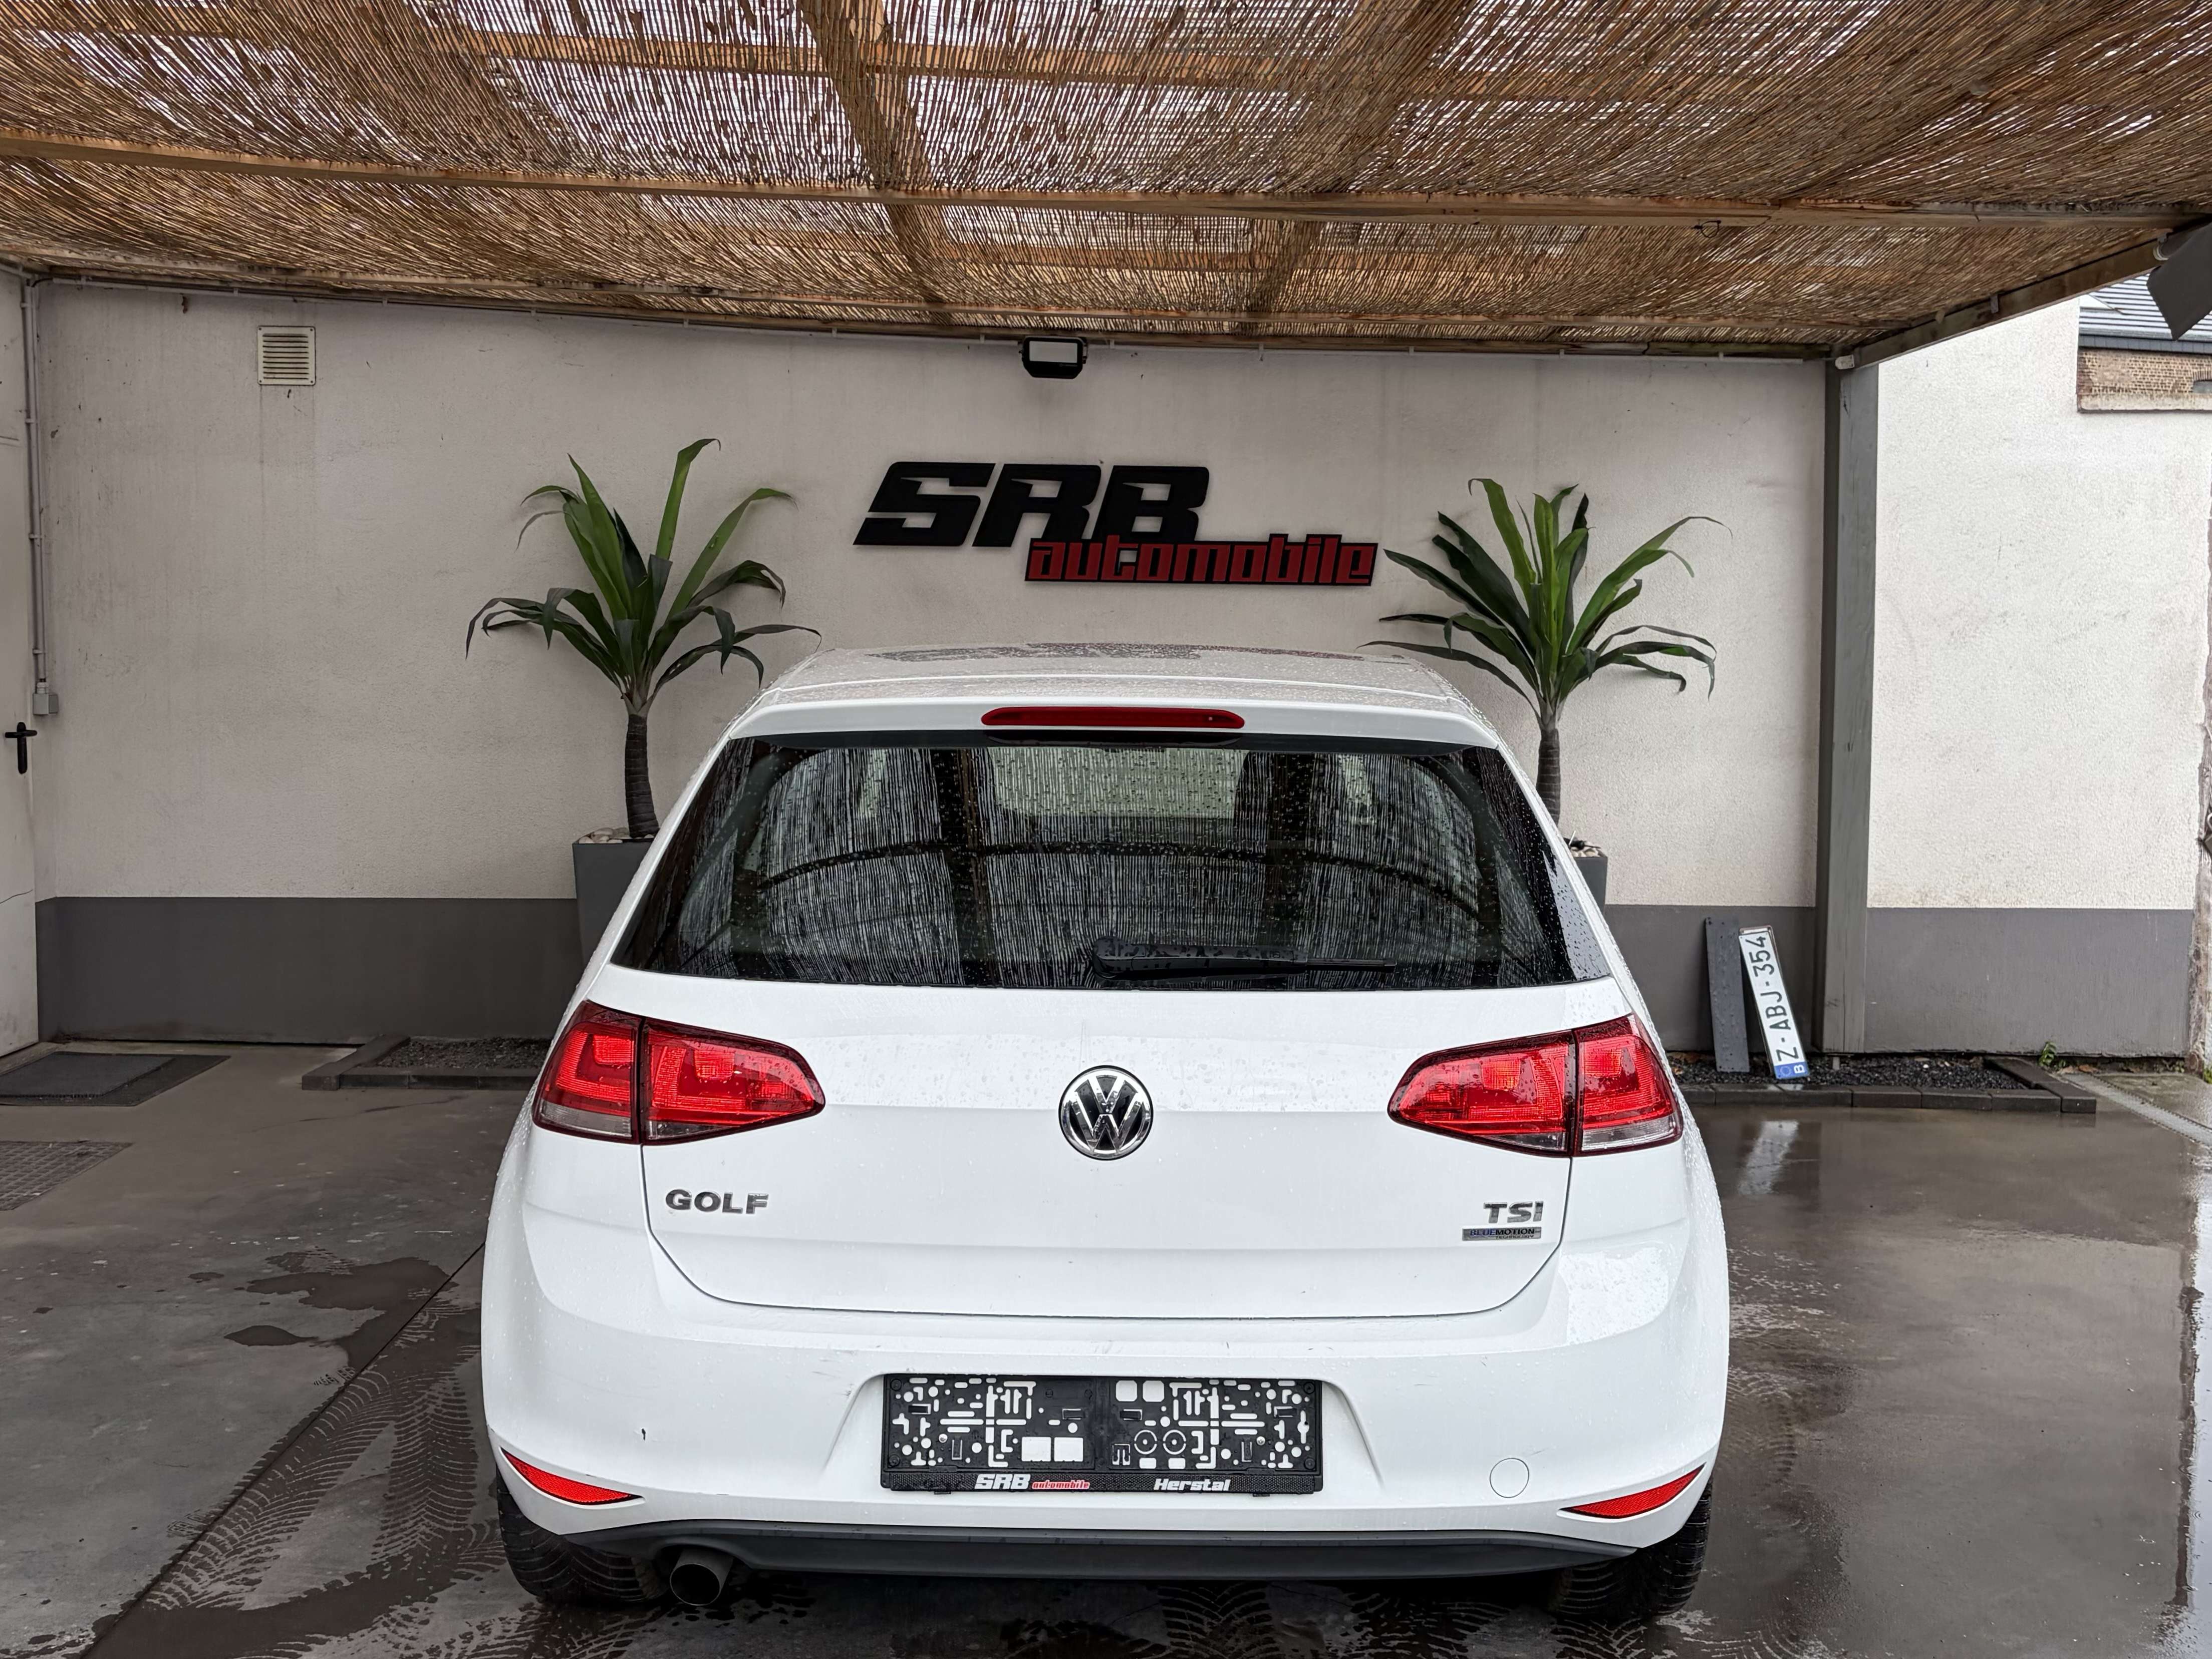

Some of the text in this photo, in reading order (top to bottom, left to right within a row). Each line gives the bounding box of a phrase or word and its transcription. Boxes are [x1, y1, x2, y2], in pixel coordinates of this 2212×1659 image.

[853, 461, 1209, 547] SRB
[1025, 533, 1377, 585] automobile
[1794, 1064, 1806, 1074] B
[1063, 1070, 1150, 1156] VW
[665, 1189, 769, 1214] GOLF
[1483, 1201, 1544, 1223] TSI
[974, 1474, 1231, 1491] SRB automobile Herstal
